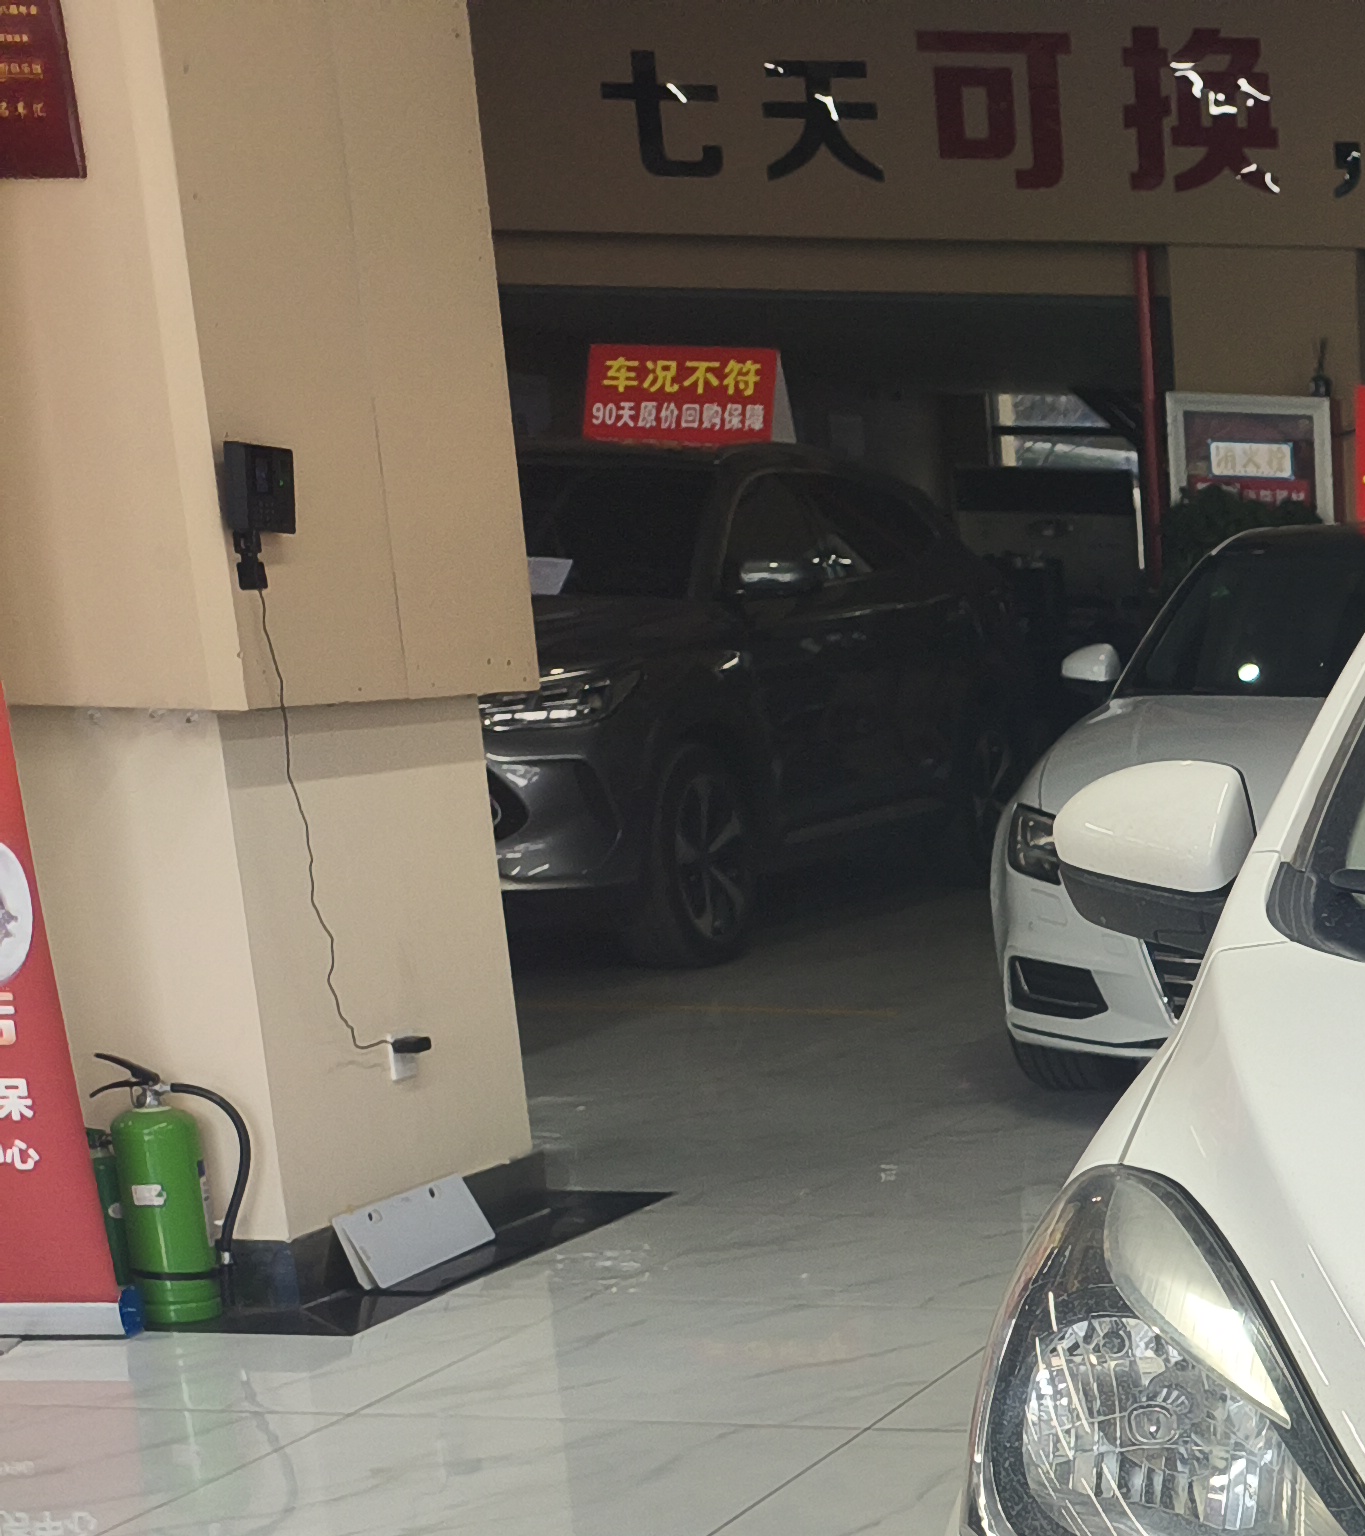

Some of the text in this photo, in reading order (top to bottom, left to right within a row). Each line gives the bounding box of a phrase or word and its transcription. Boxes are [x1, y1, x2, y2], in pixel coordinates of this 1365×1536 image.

[602, 356, 762, 397] 车况不符
[592, 402, 764, 431] 90天原价回购保障
